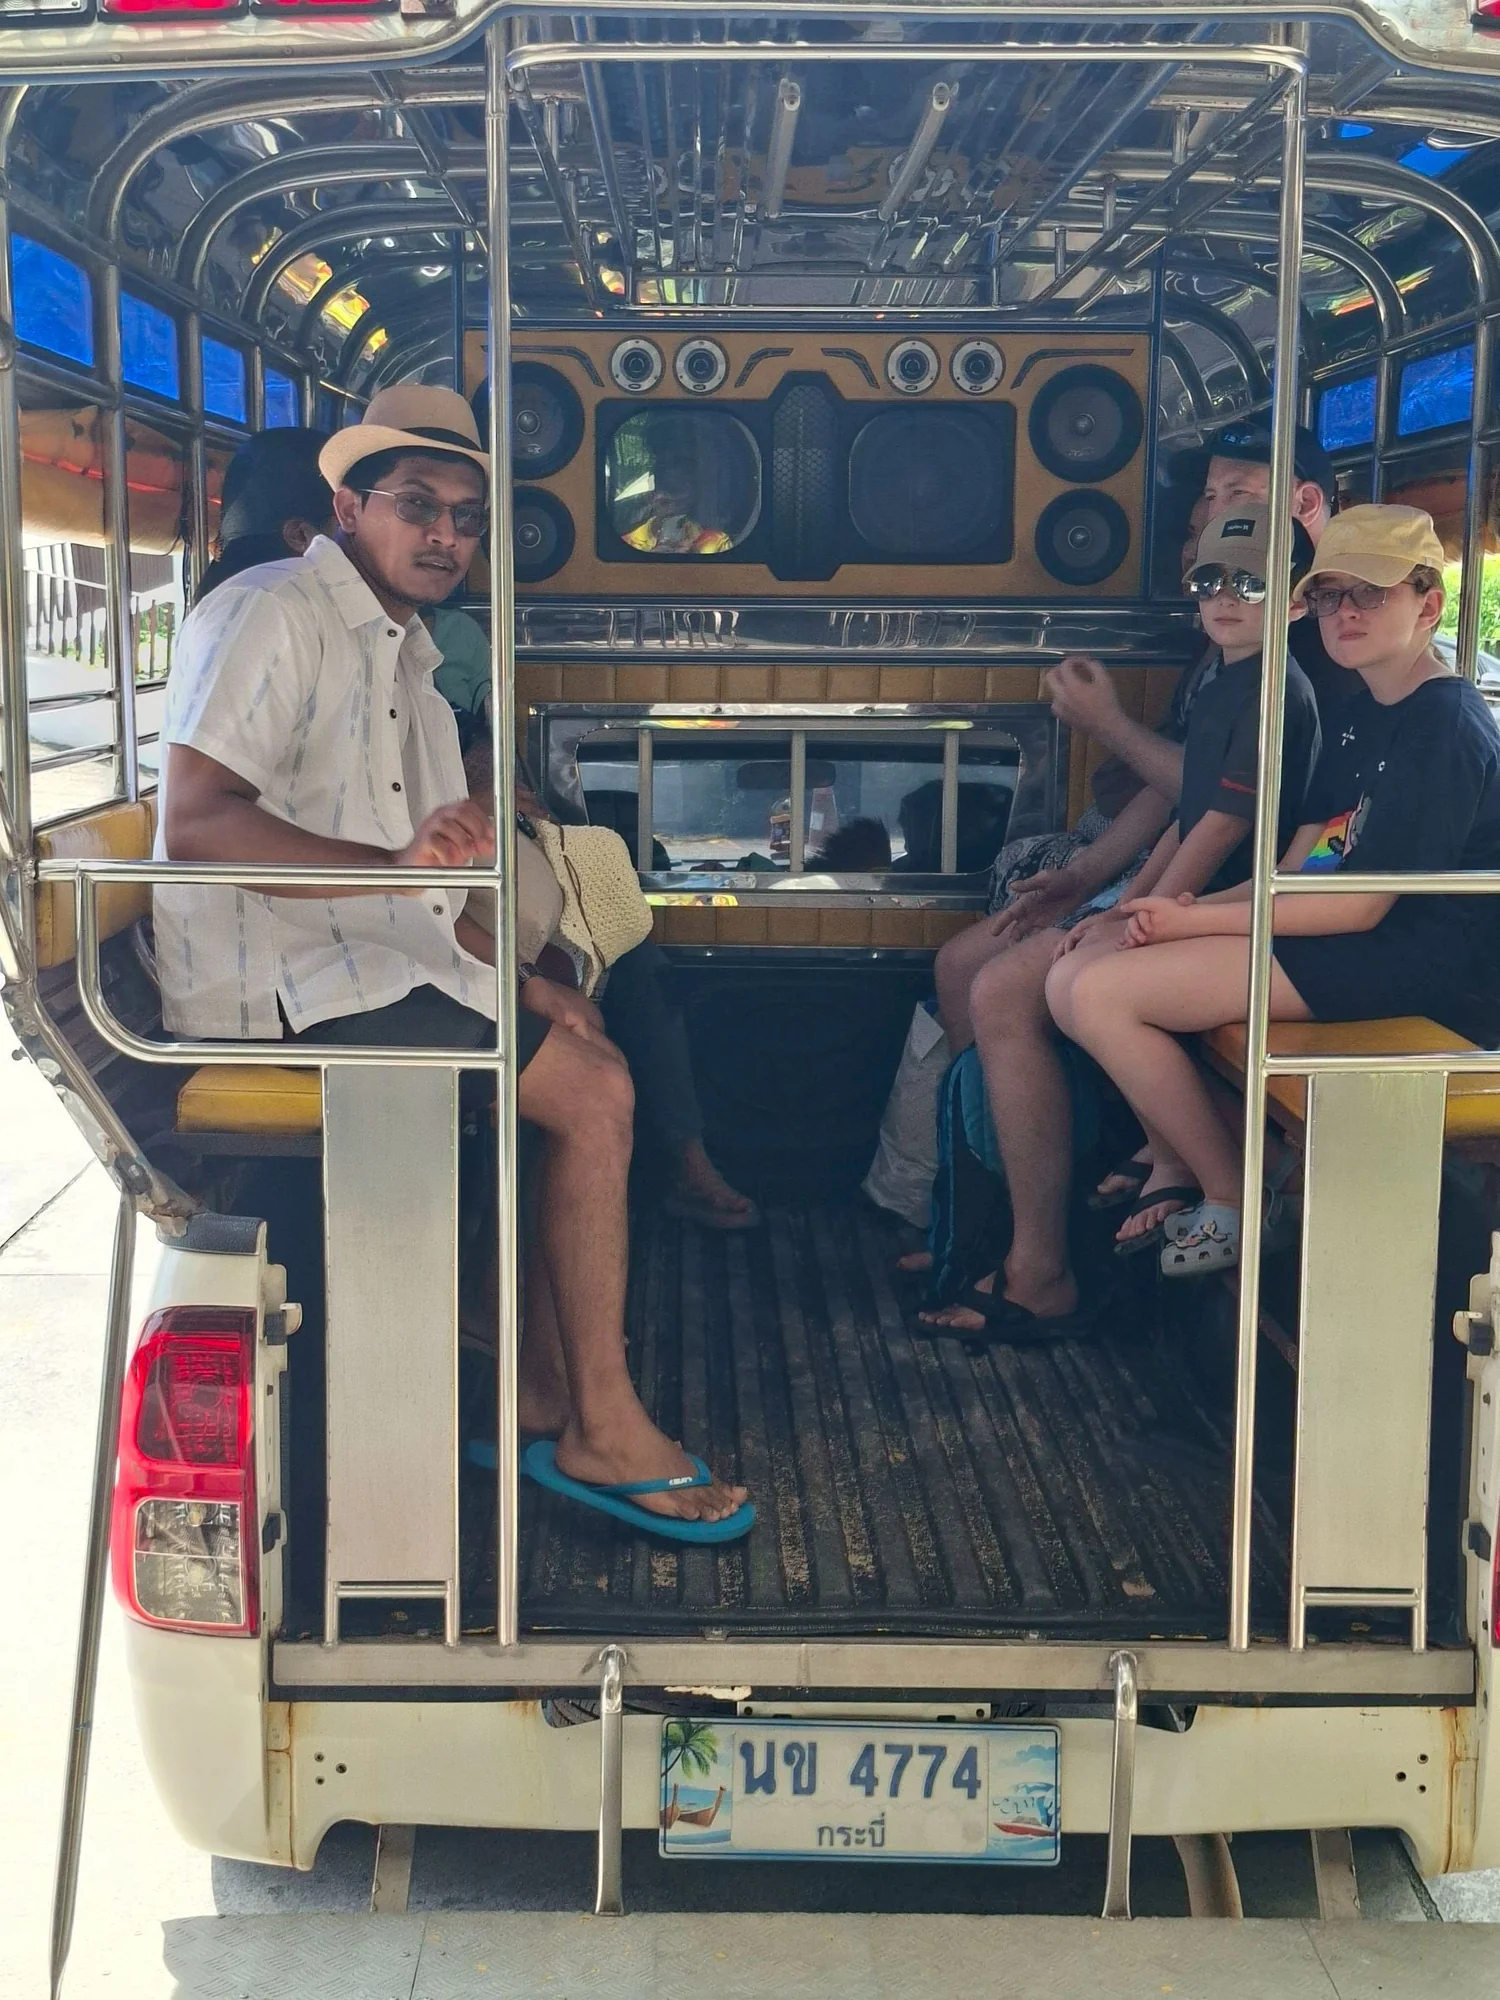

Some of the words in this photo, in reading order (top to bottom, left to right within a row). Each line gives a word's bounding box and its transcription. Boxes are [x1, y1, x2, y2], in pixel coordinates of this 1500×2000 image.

[739, 1741, 817, 1796] นข
[849, 1743, 982, 1800] 4774
[817, 1812, 886, 1848] กระบี่
